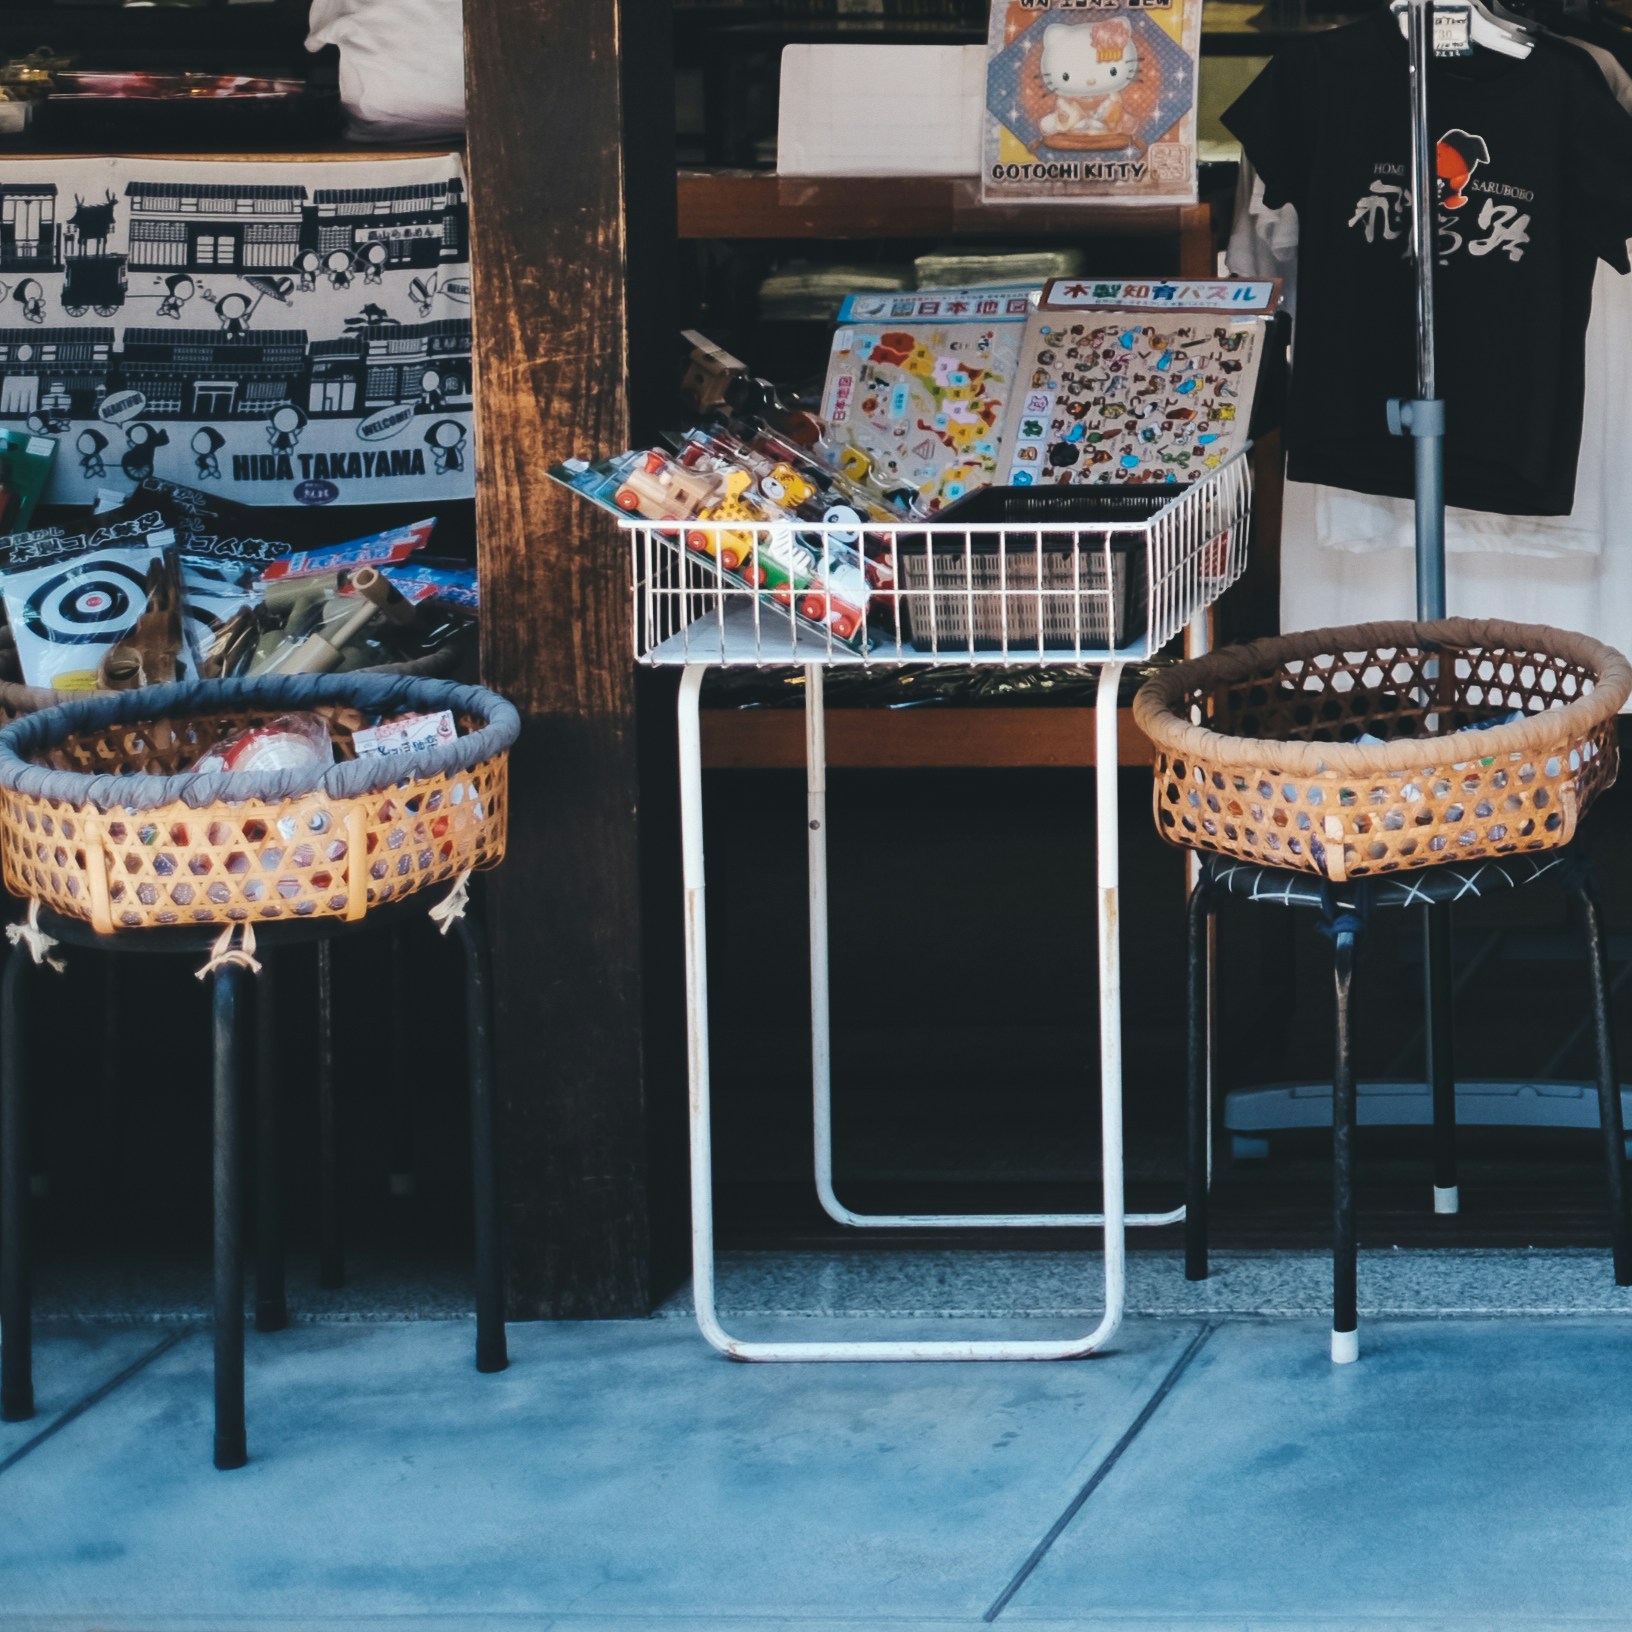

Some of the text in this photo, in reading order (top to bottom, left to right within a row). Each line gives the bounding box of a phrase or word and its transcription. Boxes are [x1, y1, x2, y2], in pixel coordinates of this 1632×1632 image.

[992, 162, 1146, 180] GOTOCHI KITTY
[1471, 179, 1535, 203] SARUBOBO
[1063, 283, 1257, 302] 木製知育パズル
[917, 299, 1028, 316] 日本地図
[232, 448, 426, 481] HIDA TAKAYAMA
